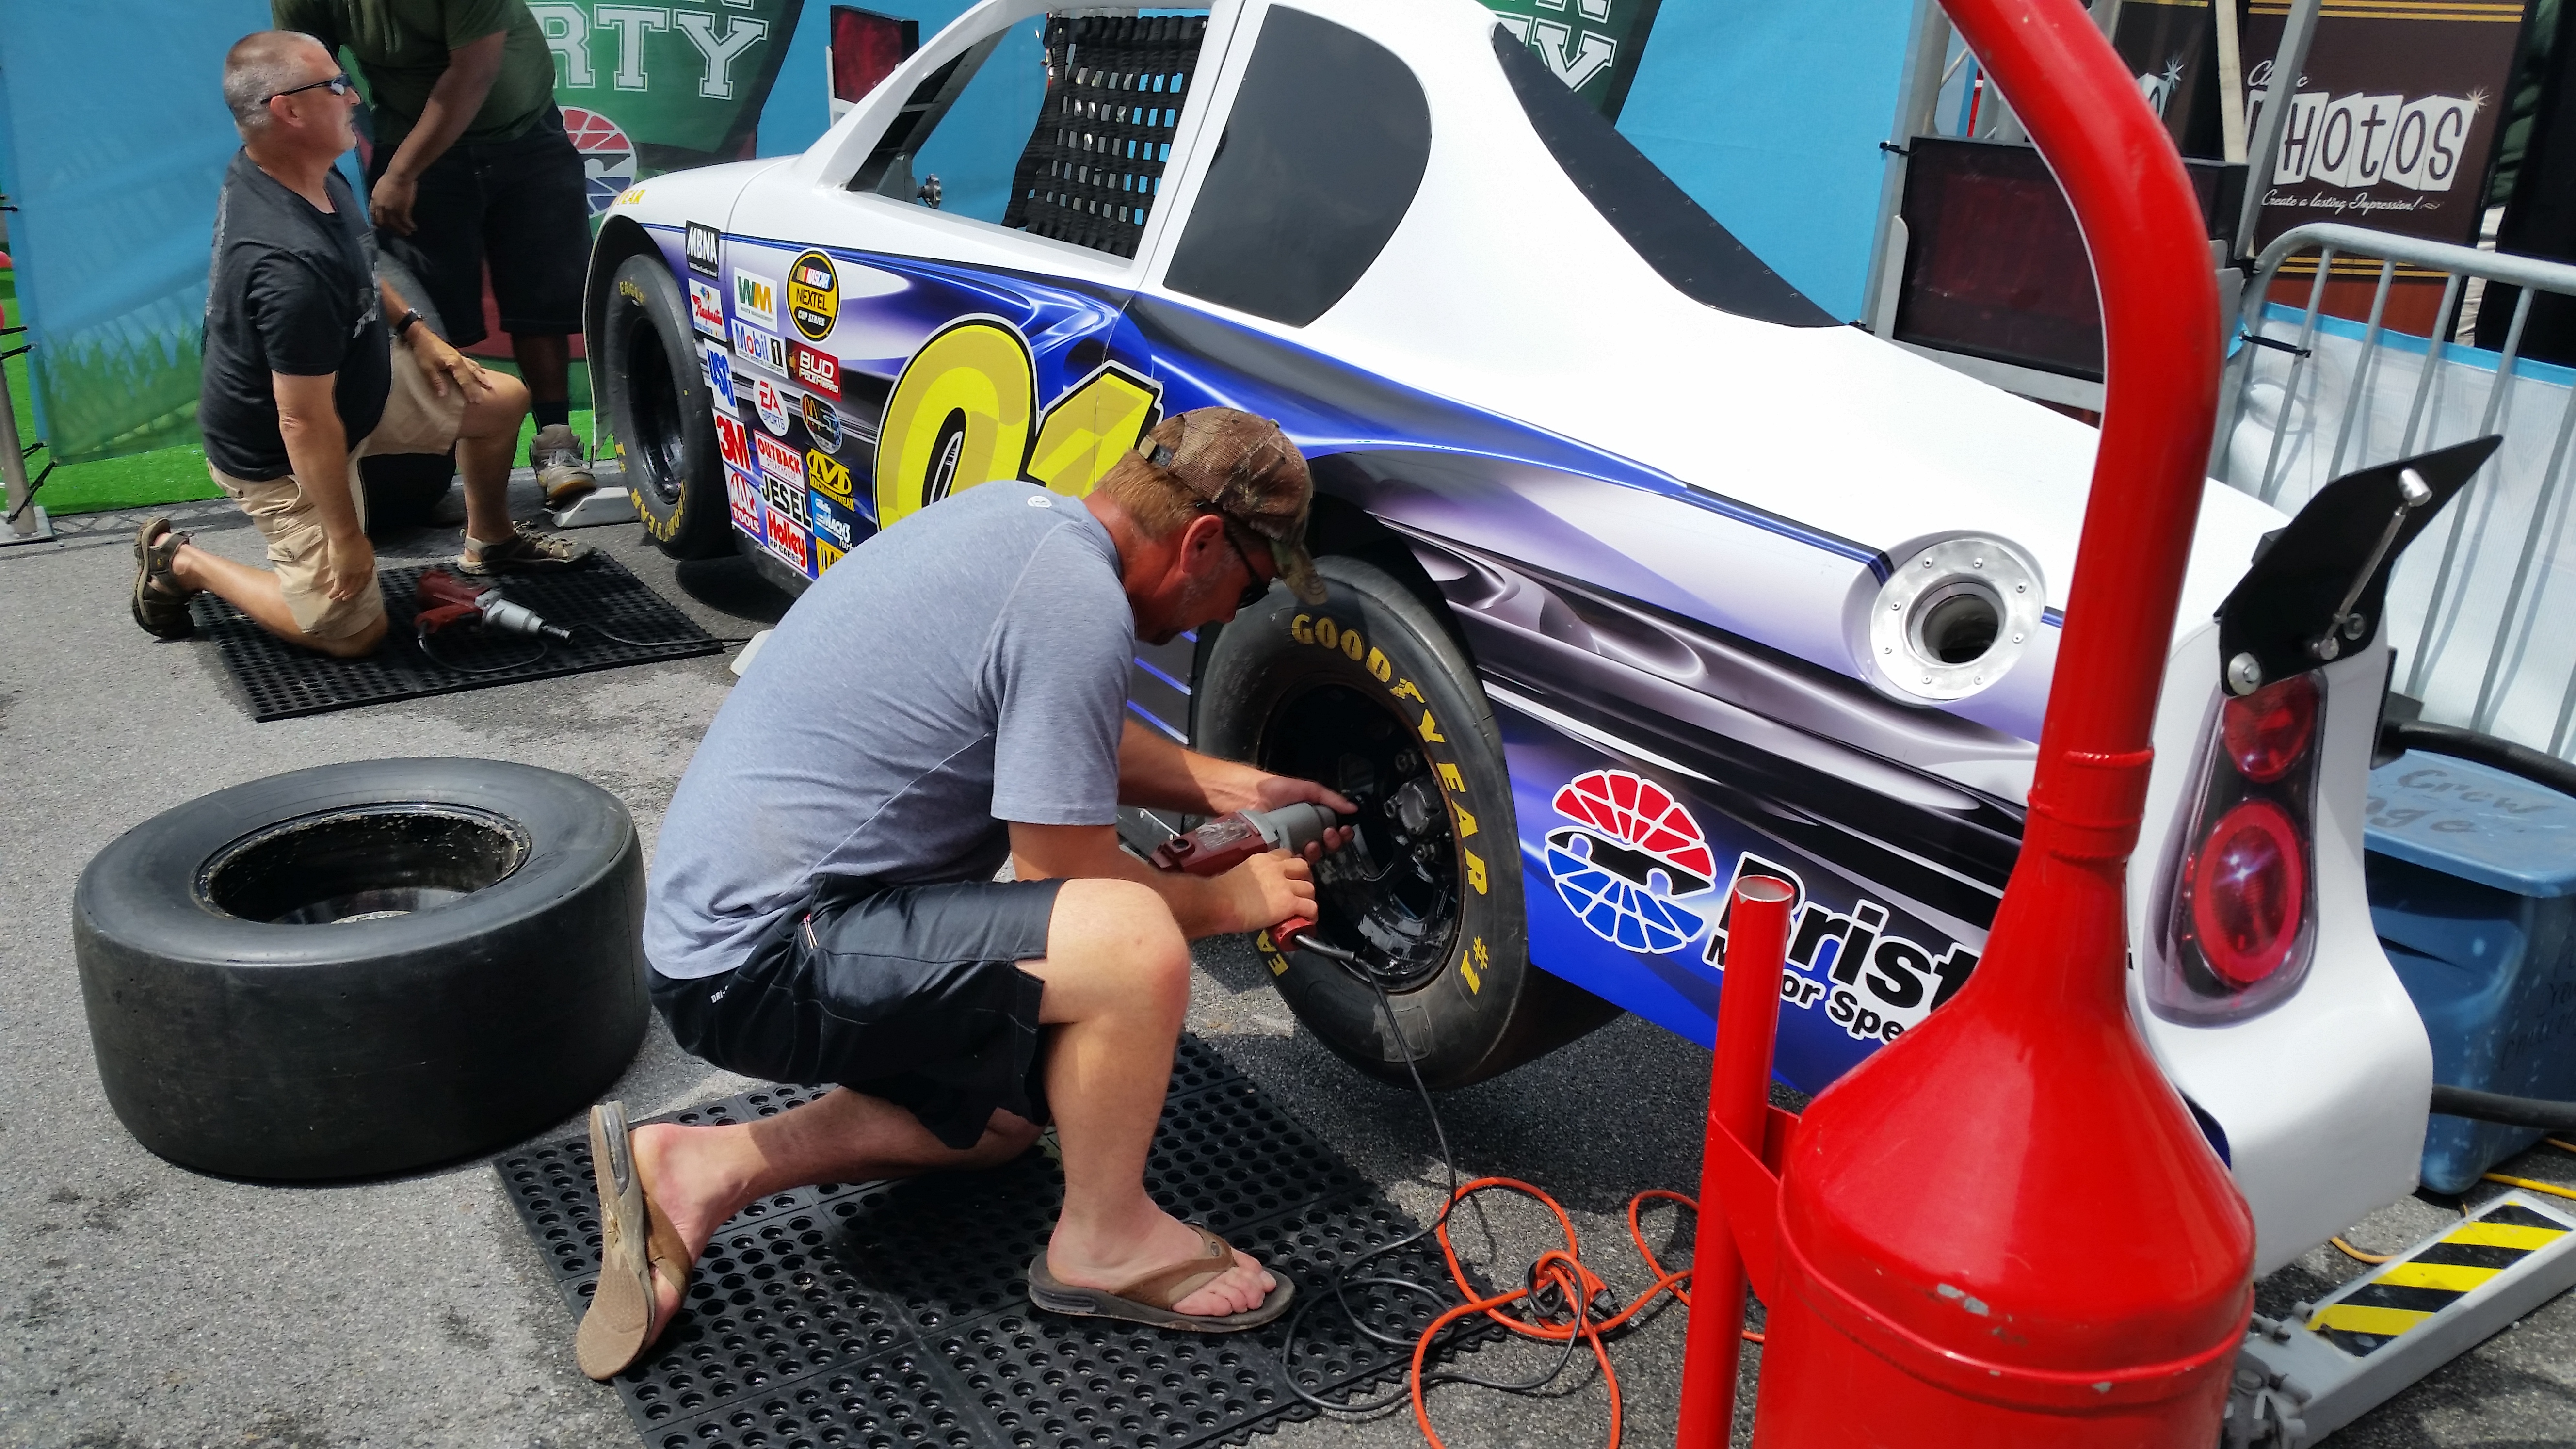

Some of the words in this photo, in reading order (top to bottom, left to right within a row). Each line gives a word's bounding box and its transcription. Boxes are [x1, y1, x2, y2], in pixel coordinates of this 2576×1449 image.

[2262, 189, 2297, 207] Create
[2299, 197, 2308, 207] a
[2310, 191, 2347, 215] lasting
[2349, 191, 2418, 216] Impression!
[687, 226, 718, 265] MBNA
[796, 288, 827, 311] NEXTEL
[798, 310, 807, 321] CUP
[808, 313, 825, 327] SERIES
[735, 323, 769, 362] Mobil
[772, 340, 780, 365] 1
[800, 350, 834, 378] BUD
[759, 380, 782, 416] EA
[761, 409, 785, 431] SPORTS
[716, 415, 751, 471] 3M
[757, 437, 802, 477] OUTBACK
[731, 475, 758, 519] MAC
[761, 474, 812, 529] JESEL
[732, 505, 760, 534] TOOLS
[767, 511, 805, 568] Holley
[778, 544, 800, 565] CARBS
[1291, 613, 1489, 896] GOODYEAR
[1459, 935, 1490, 996] #1
[2397, 768, 2557, 814] Crew
